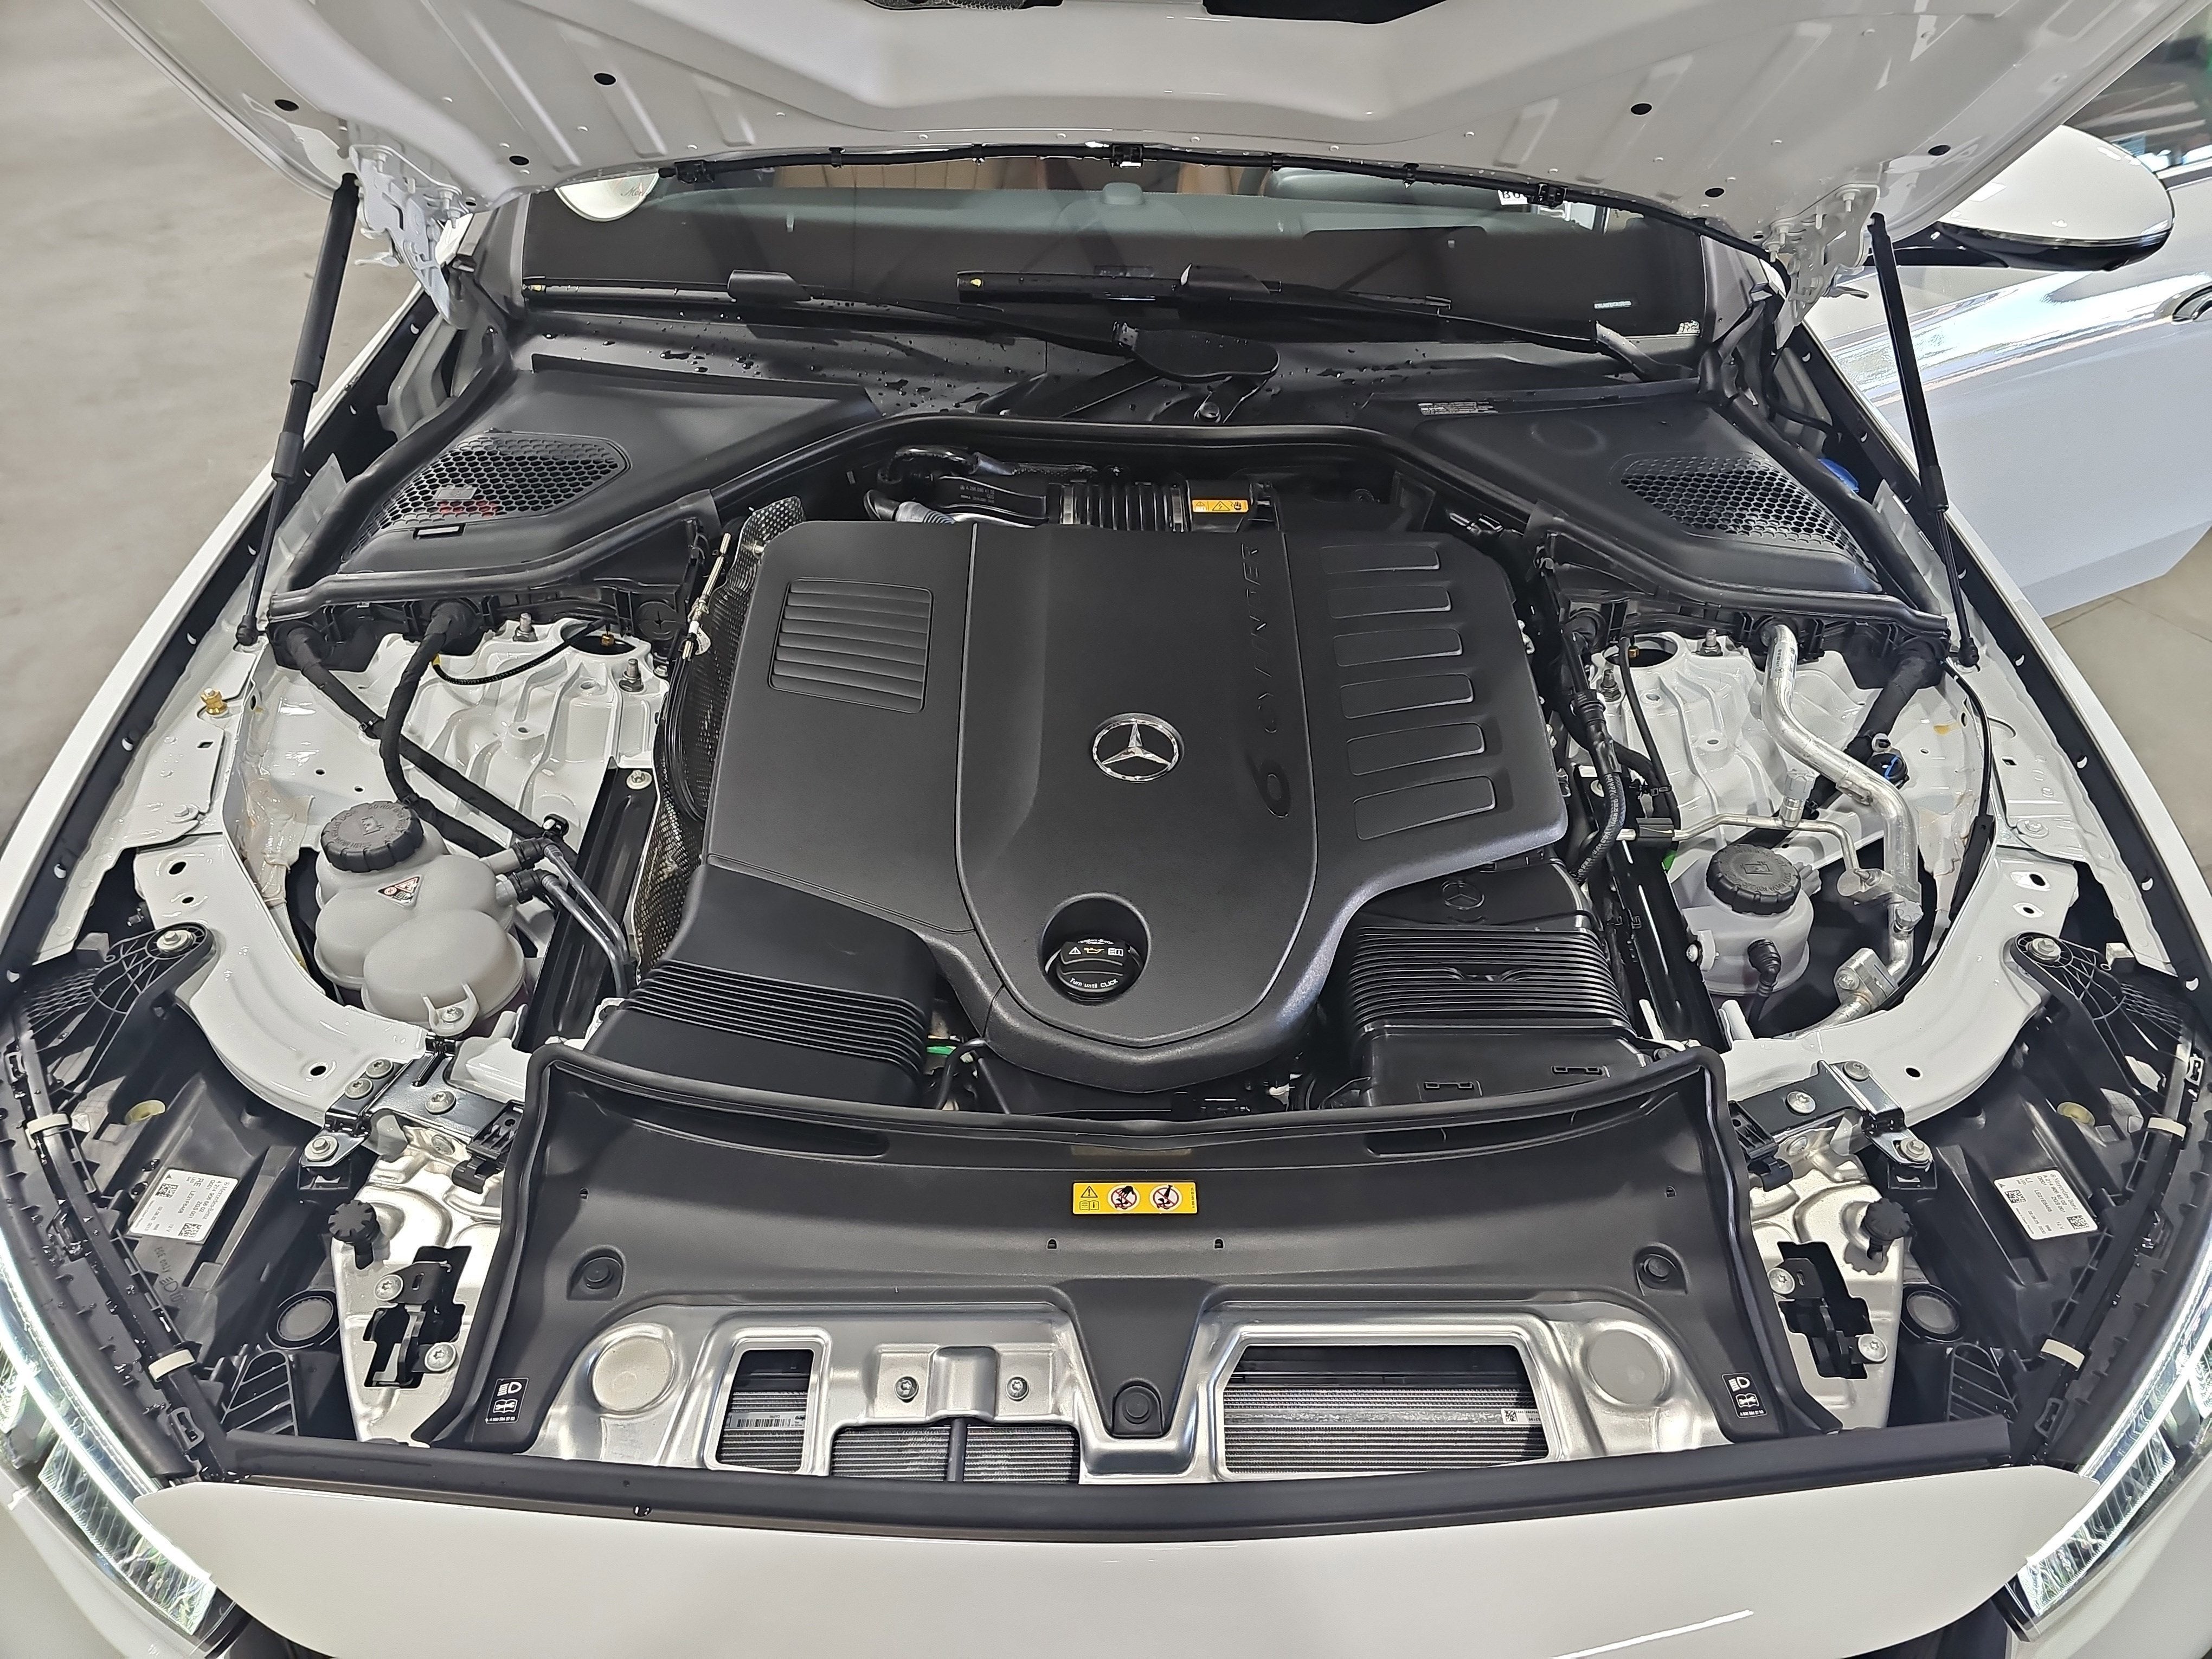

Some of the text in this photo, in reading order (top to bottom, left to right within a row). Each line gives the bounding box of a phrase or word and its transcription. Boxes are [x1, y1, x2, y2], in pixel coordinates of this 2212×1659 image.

[1070, 978, 1082, 986] Turn
[1100, 979, 1118, 988] CLICK
[193, 1178, 204, 1187] RE
[2054, 1178, 2079, 1210] Mercedes-Benz
[203, 1186, 226, 1219] Mercedes-Benz
[2050, 1196, 2060, 1205] ZGS
[192, 1201, 202, 1210] ZGS
